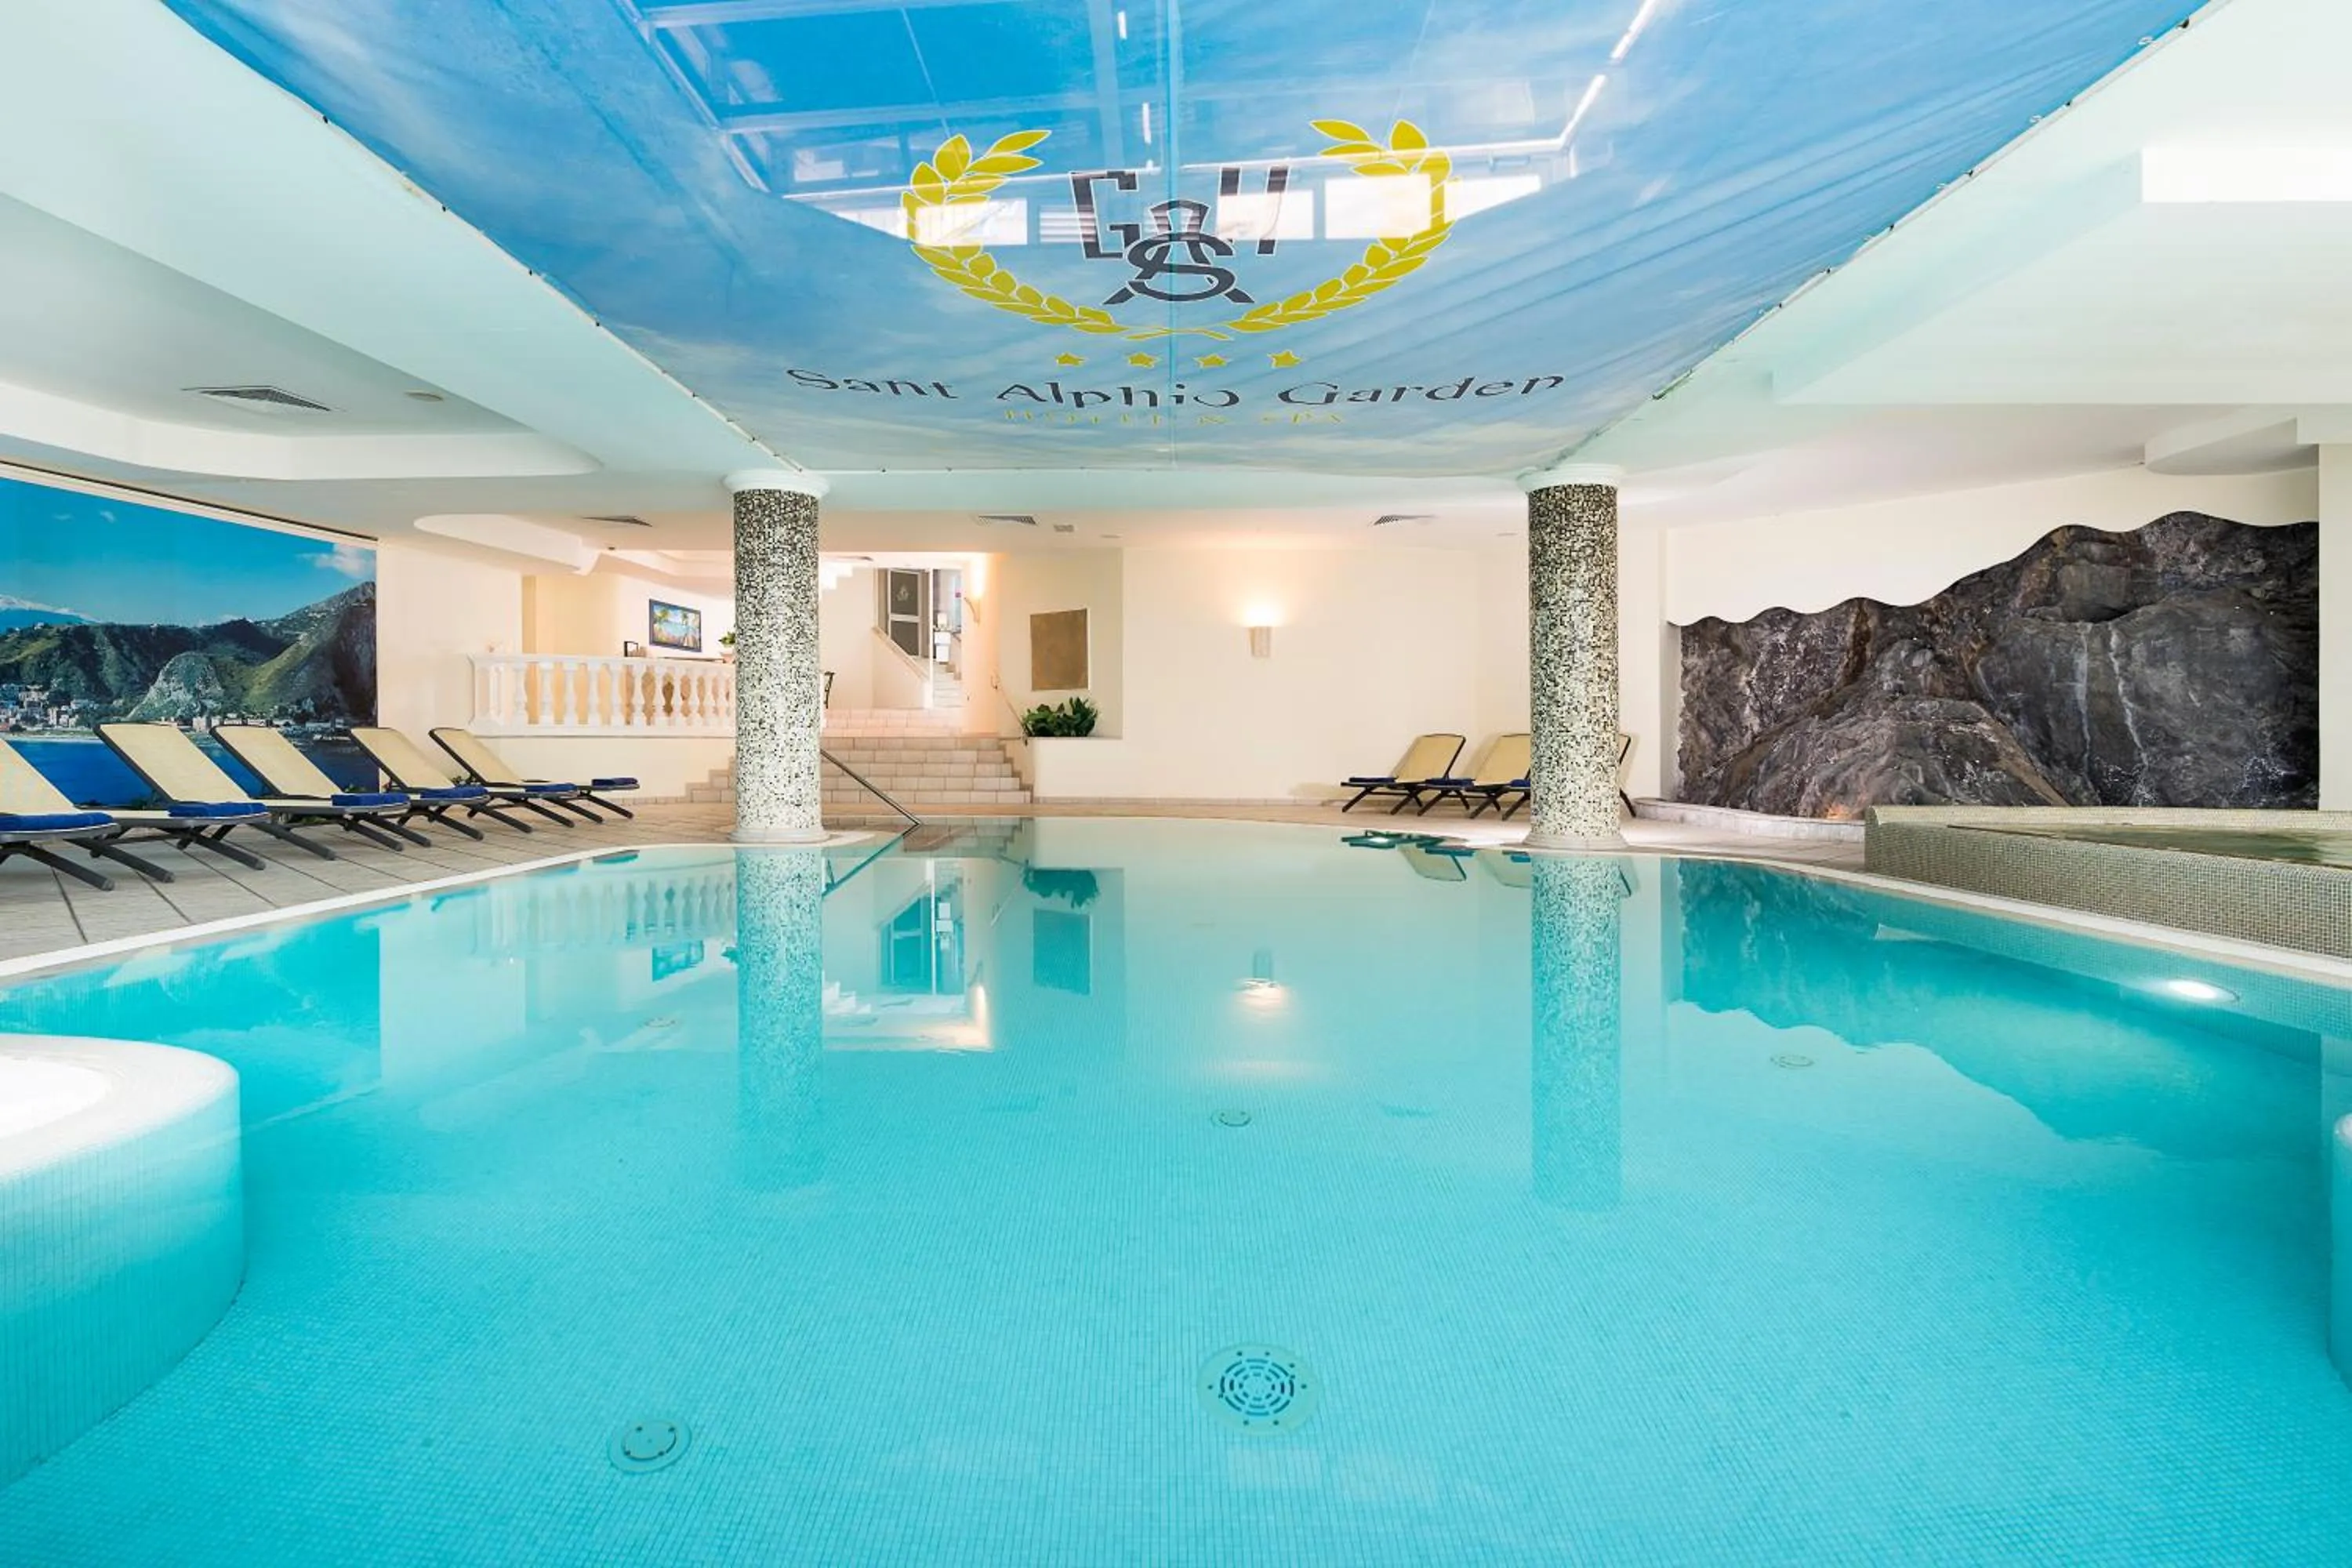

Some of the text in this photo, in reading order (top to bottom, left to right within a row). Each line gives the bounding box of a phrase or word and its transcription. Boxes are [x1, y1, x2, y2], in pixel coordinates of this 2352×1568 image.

[786, 368, 1565, 408] Sant Alphio Garden
